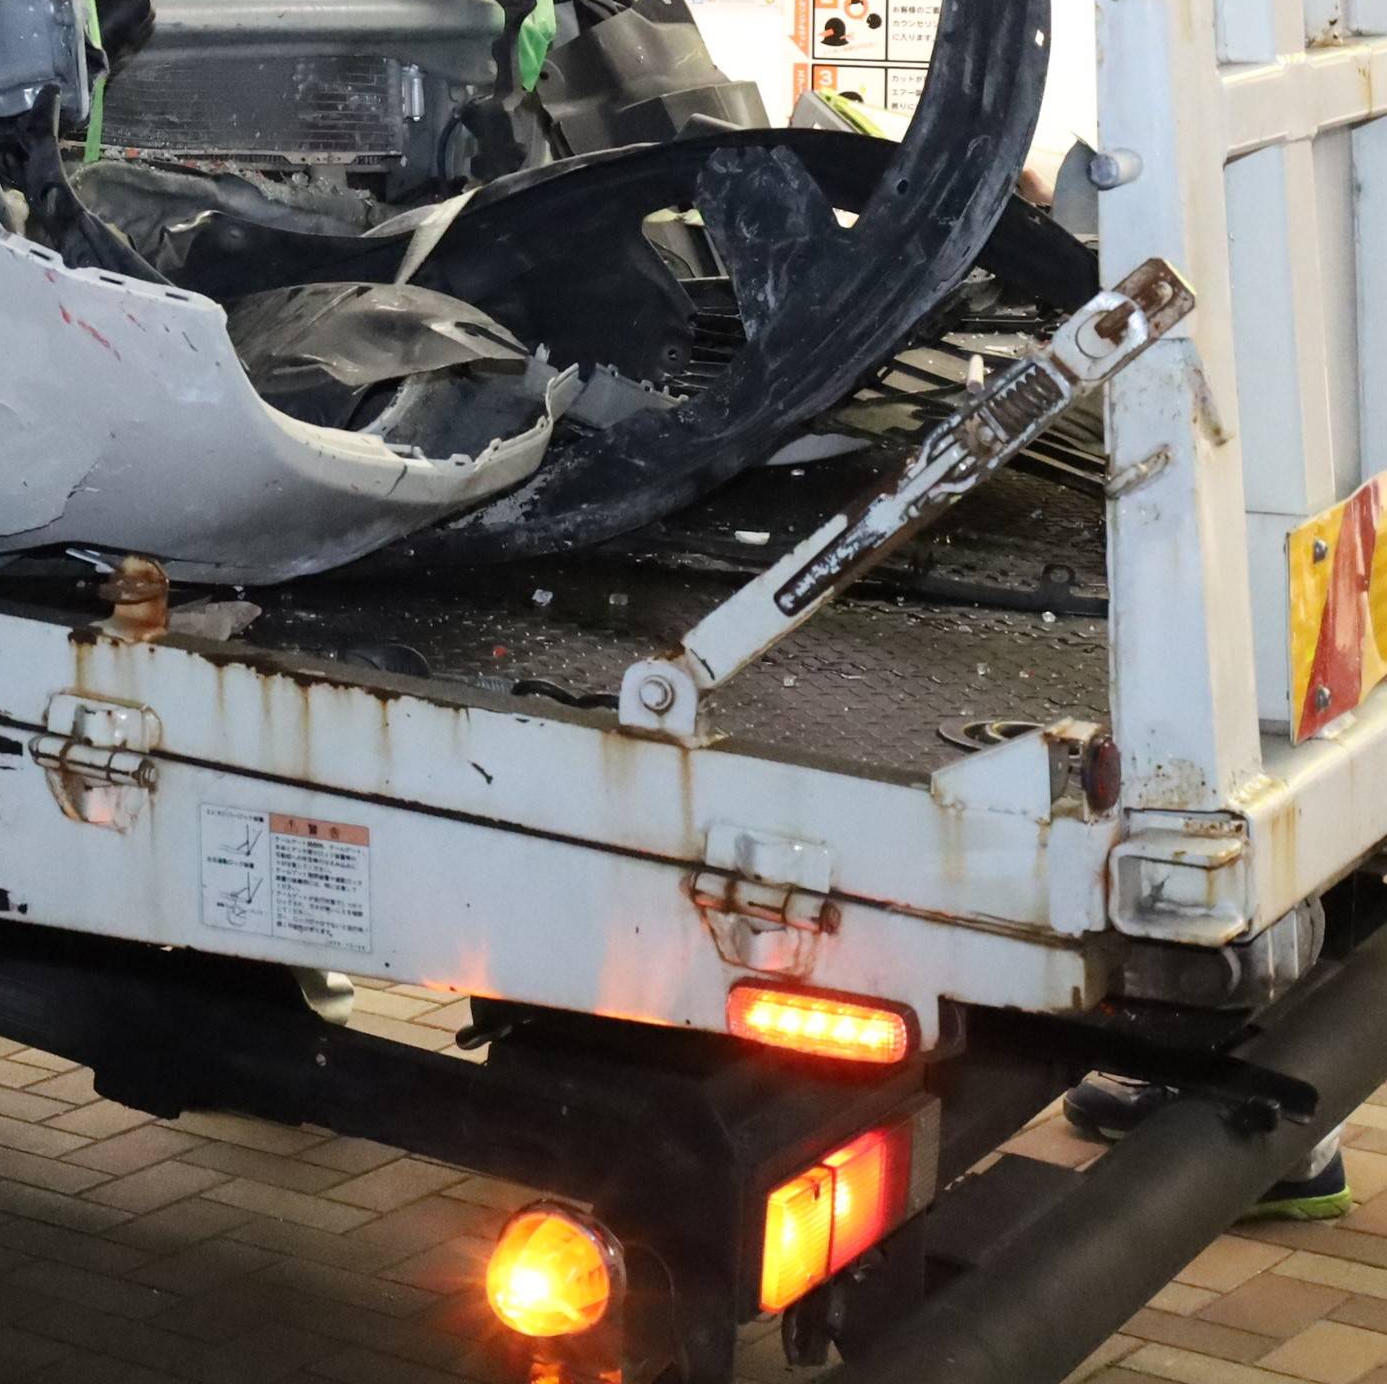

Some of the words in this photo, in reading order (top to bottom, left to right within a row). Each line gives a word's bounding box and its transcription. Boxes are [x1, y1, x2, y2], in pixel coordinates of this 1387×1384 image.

[819, 70, 833, 86] 3
[891, 74, 927, 83] カットが
